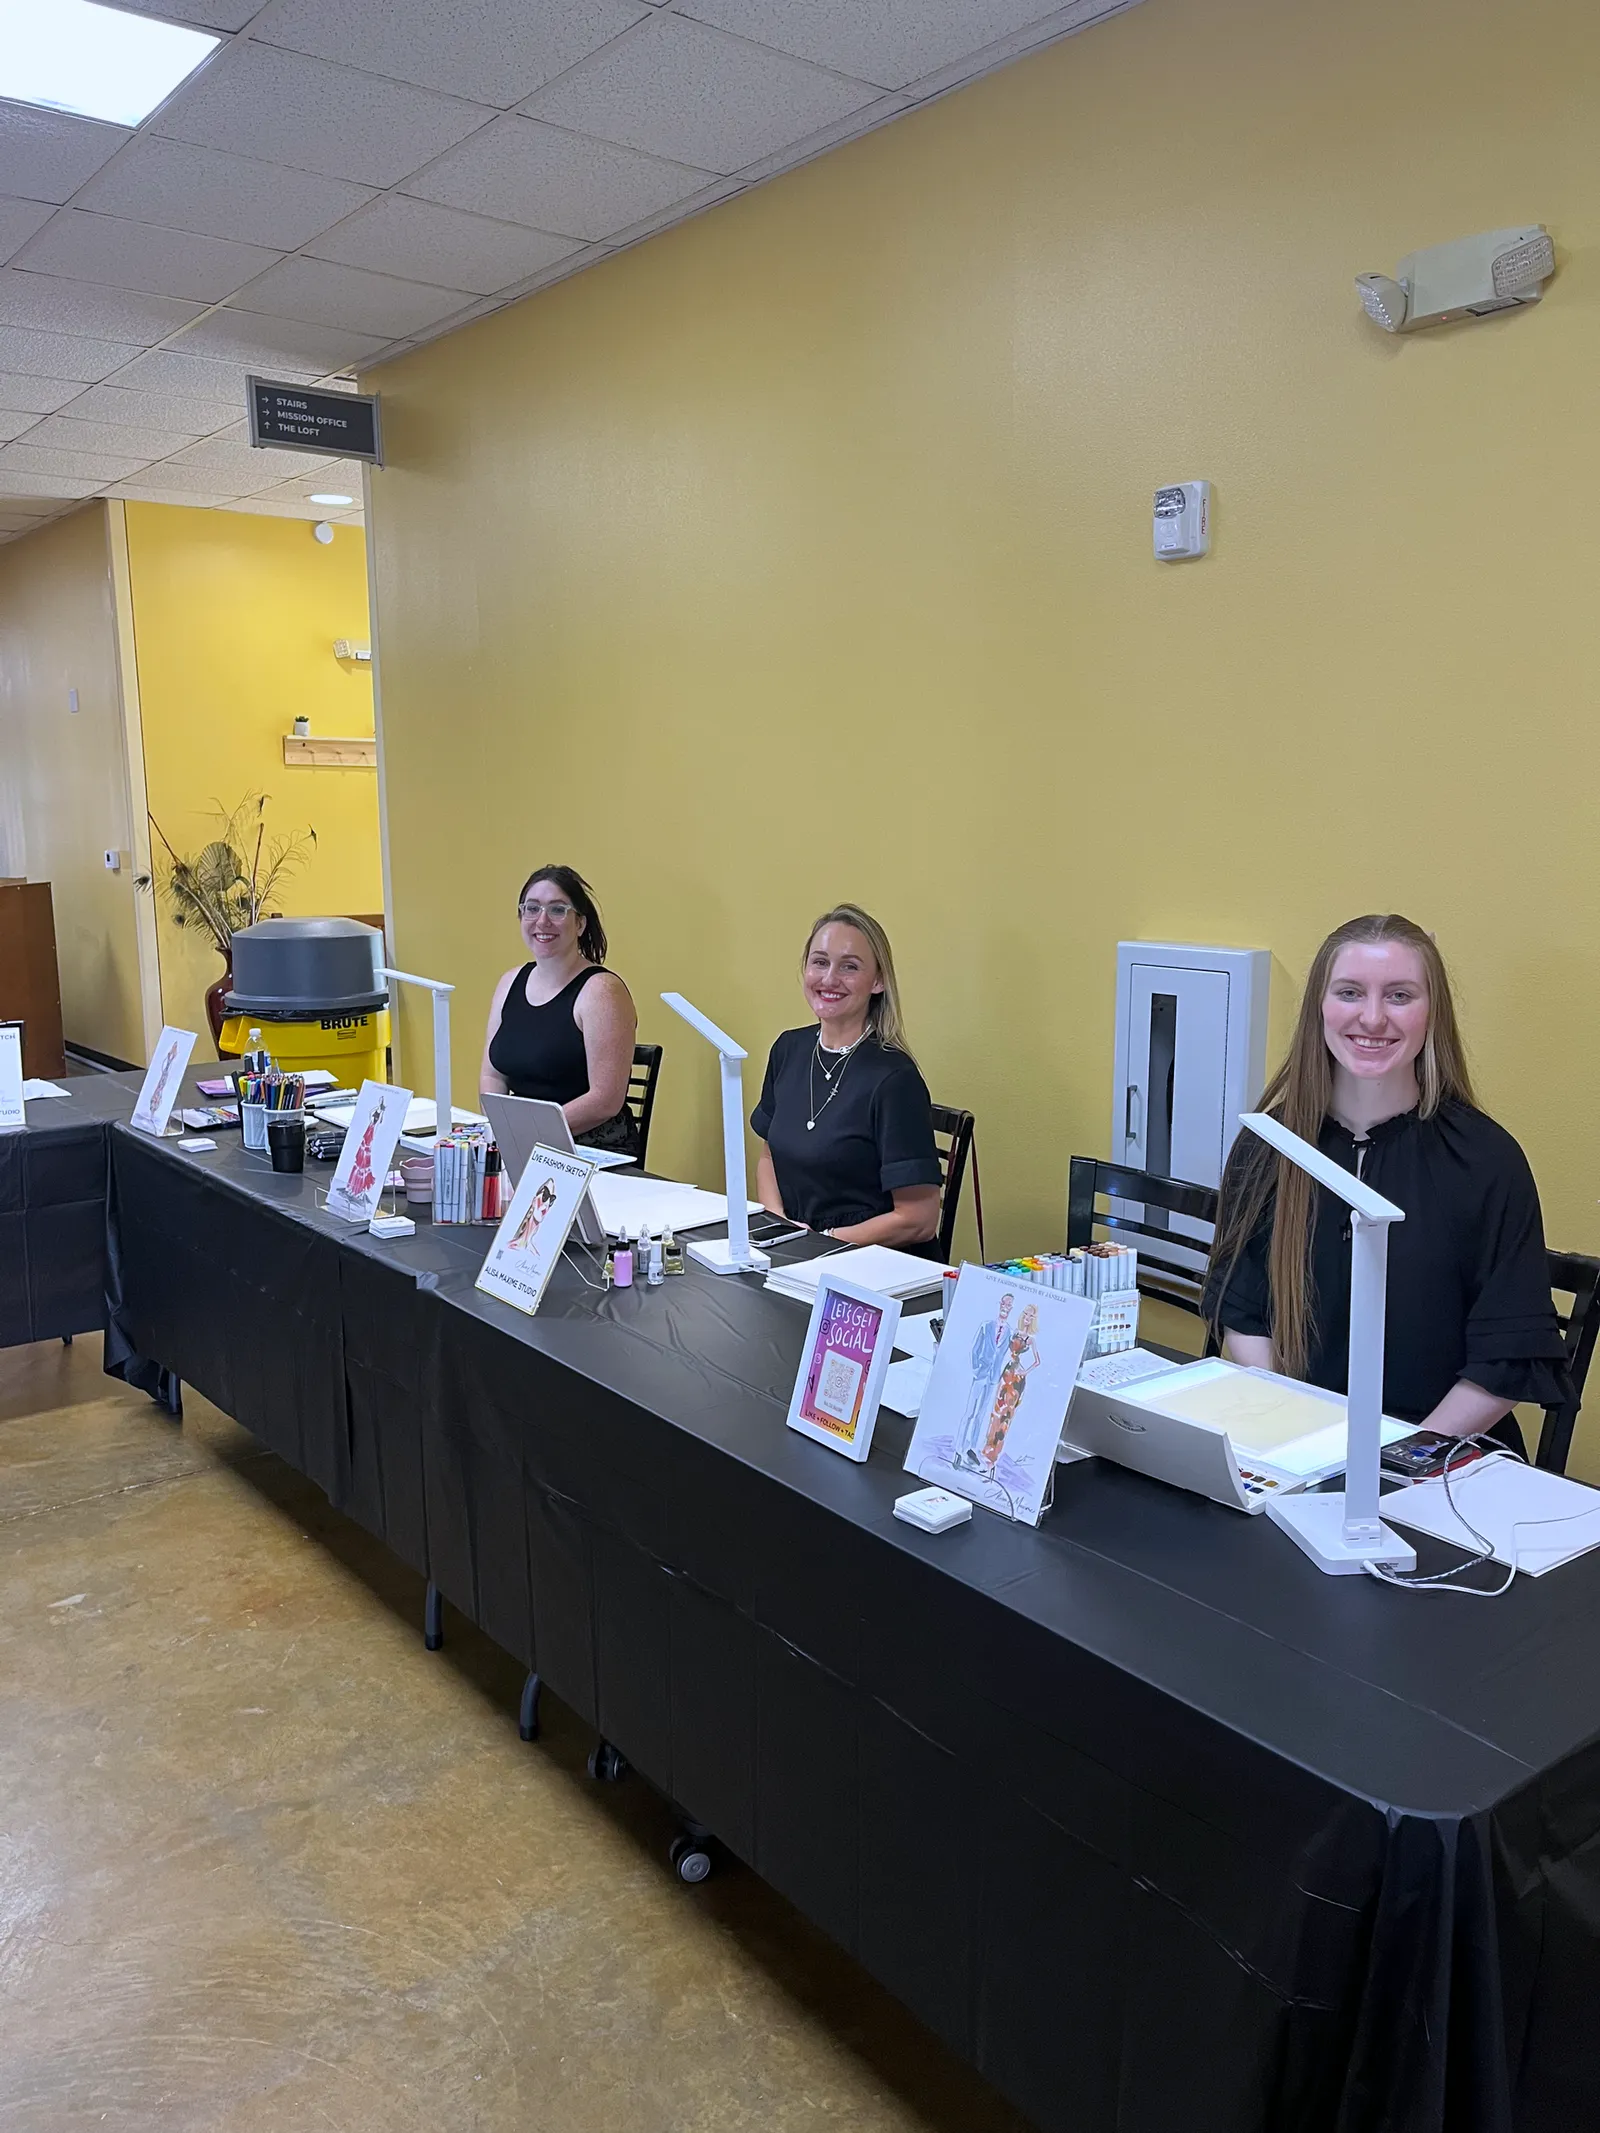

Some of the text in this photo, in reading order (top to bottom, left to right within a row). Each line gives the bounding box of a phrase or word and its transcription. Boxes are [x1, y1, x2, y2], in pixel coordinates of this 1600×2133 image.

[276, 397, 308, 409] STAIRS
[277, 410, 348, 428] MISSION OFFICE
[278, 423, 321, 437] THE LOFT
[321, 1016, 369, 1030] BRUTE
[531, 1150, 589, 1179] LIVE FASHION SKETCH
[485, 1266, 499, 1277] ALISA
[499, 1272, 519, 1288] MAXIME
[518, 1282, 537, 1297] STUDIO
[852, 1305, 876, 1328] GET
[805, 1410, 816, 1420] LIKE
[820, 1417, 840, 1432] FOLLOW
